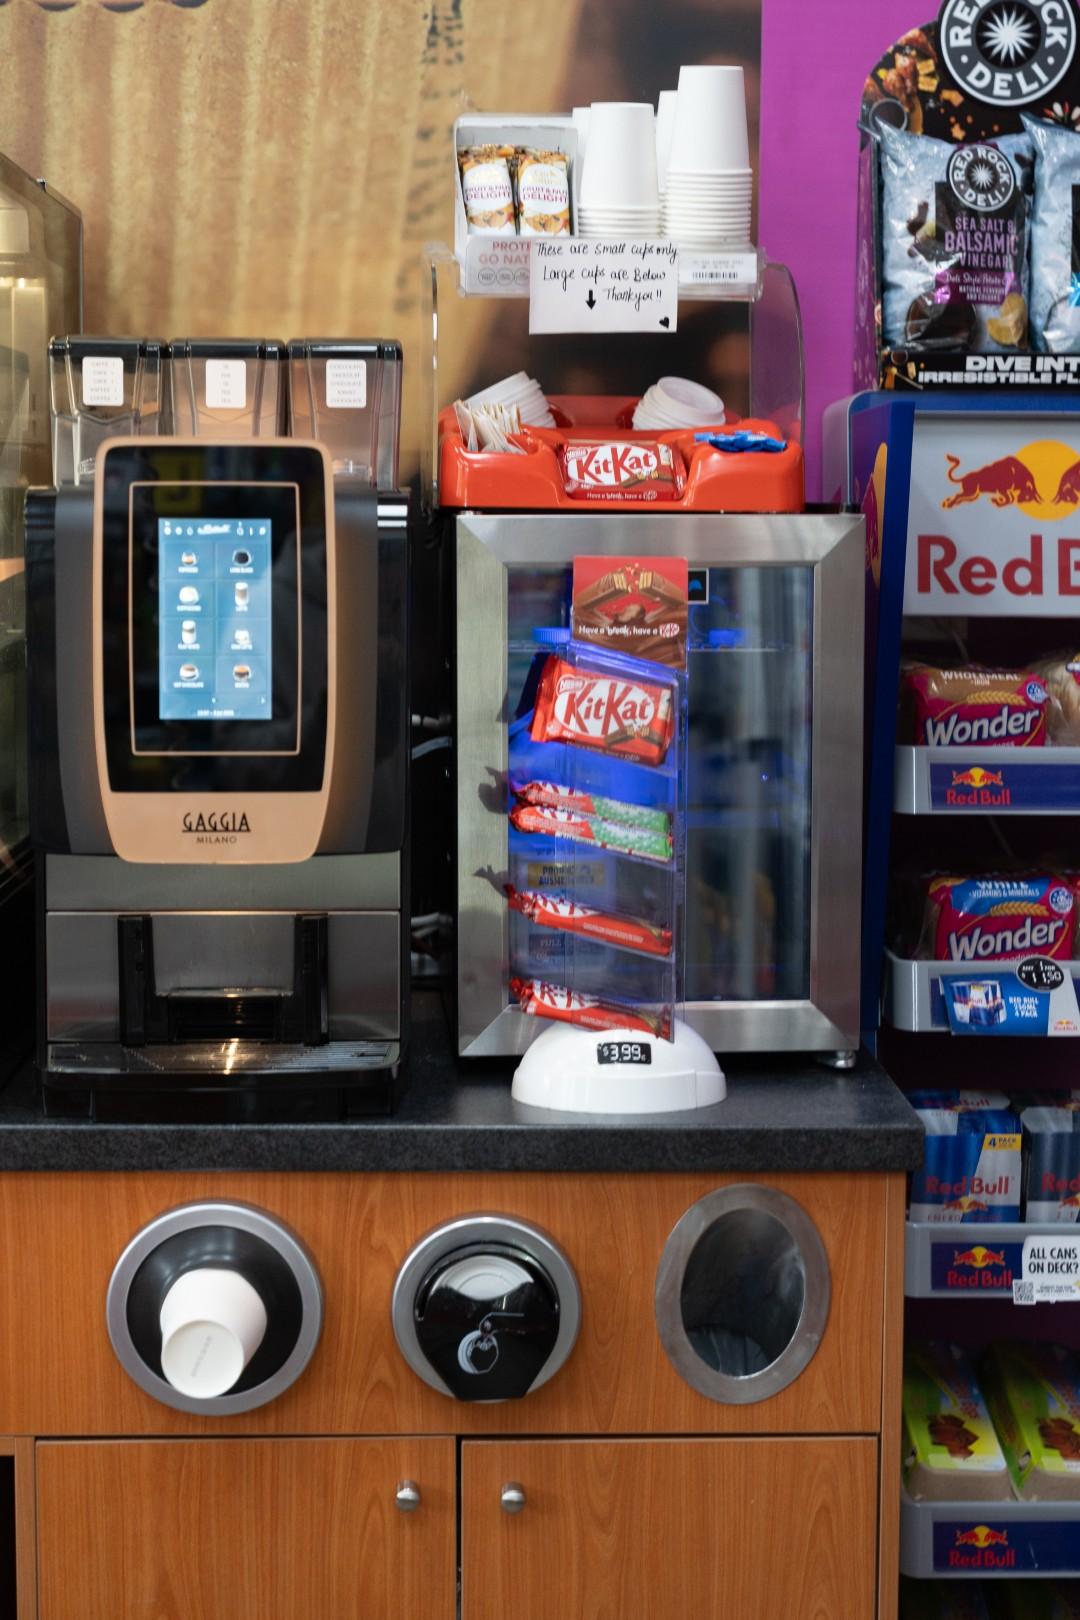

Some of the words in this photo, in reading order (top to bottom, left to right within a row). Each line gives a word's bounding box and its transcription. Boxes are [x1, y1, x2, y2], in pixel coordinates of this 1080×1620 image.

[949, 0, 989, 47] RE
[966, 62, 1049, 97] DELI
[954, 149, 973, 181] RED
[977, 147, 1010, 185] ROCK
[964, 188, 1003, 206] DELI
[955, 216, 976, 230] SEA
[980, 217, 1005, 232] SALT
[944, 230, 1019, 254] BALSAMIC
[479, 254, 499, 264] GO
[536, 242, 562, 256] These
[570, 244, 589, 255] are
[656, 242, 679, 264] only
[960, 251, 1011, 268] VINEGAR
[543, 265, 575, 292] Large
[610, 269, 629, 281] are
[634, 267, 666, 282] Below
[966, 355, 1031, 371] DIVE
[918, 371, 1053, 384] IRRESISTIBLE
[1056, 373, 1080, 385] FL
[576, 446, 653, 484] KitKat
[917, 534, 1043, 595] Red
[579, 625, 598, 635] Have
[633, 625, 650, 635] have
[653, 627, 658, 635] a
[940, 671, 1022, 681] WHOLEMEAL
[563, 681, 651, 736] KitKat
[926, 705, 1039, 747] Wonder
[946, 789, 977, 805] Red
[980, 789, 1010, 805] Bull
[182, 811, 251, 832] GAGGIA
[196, 836, 238, 844] MILANO
[949, 917, 1063, 961] Wonder
[988, 1138, 996, 1147] 4
[926, 1176, 966, 1195] Red
[971, 1176, 1009, 1195] Bull
[1030, 1248, 1047, 1259] ALL
[1050, 1247, 1077, 1260] CANS
[1028, 1262, 1044, 1273] ON
[1047, 1262, 1079, 1273] DECK?
[947, 1270, 978, 1288] Red
[981, 1270, 1012, 1288] Bull
[950, 1550, 981, 1567] Red
[984, 1550, 1015, 1567] Bull
